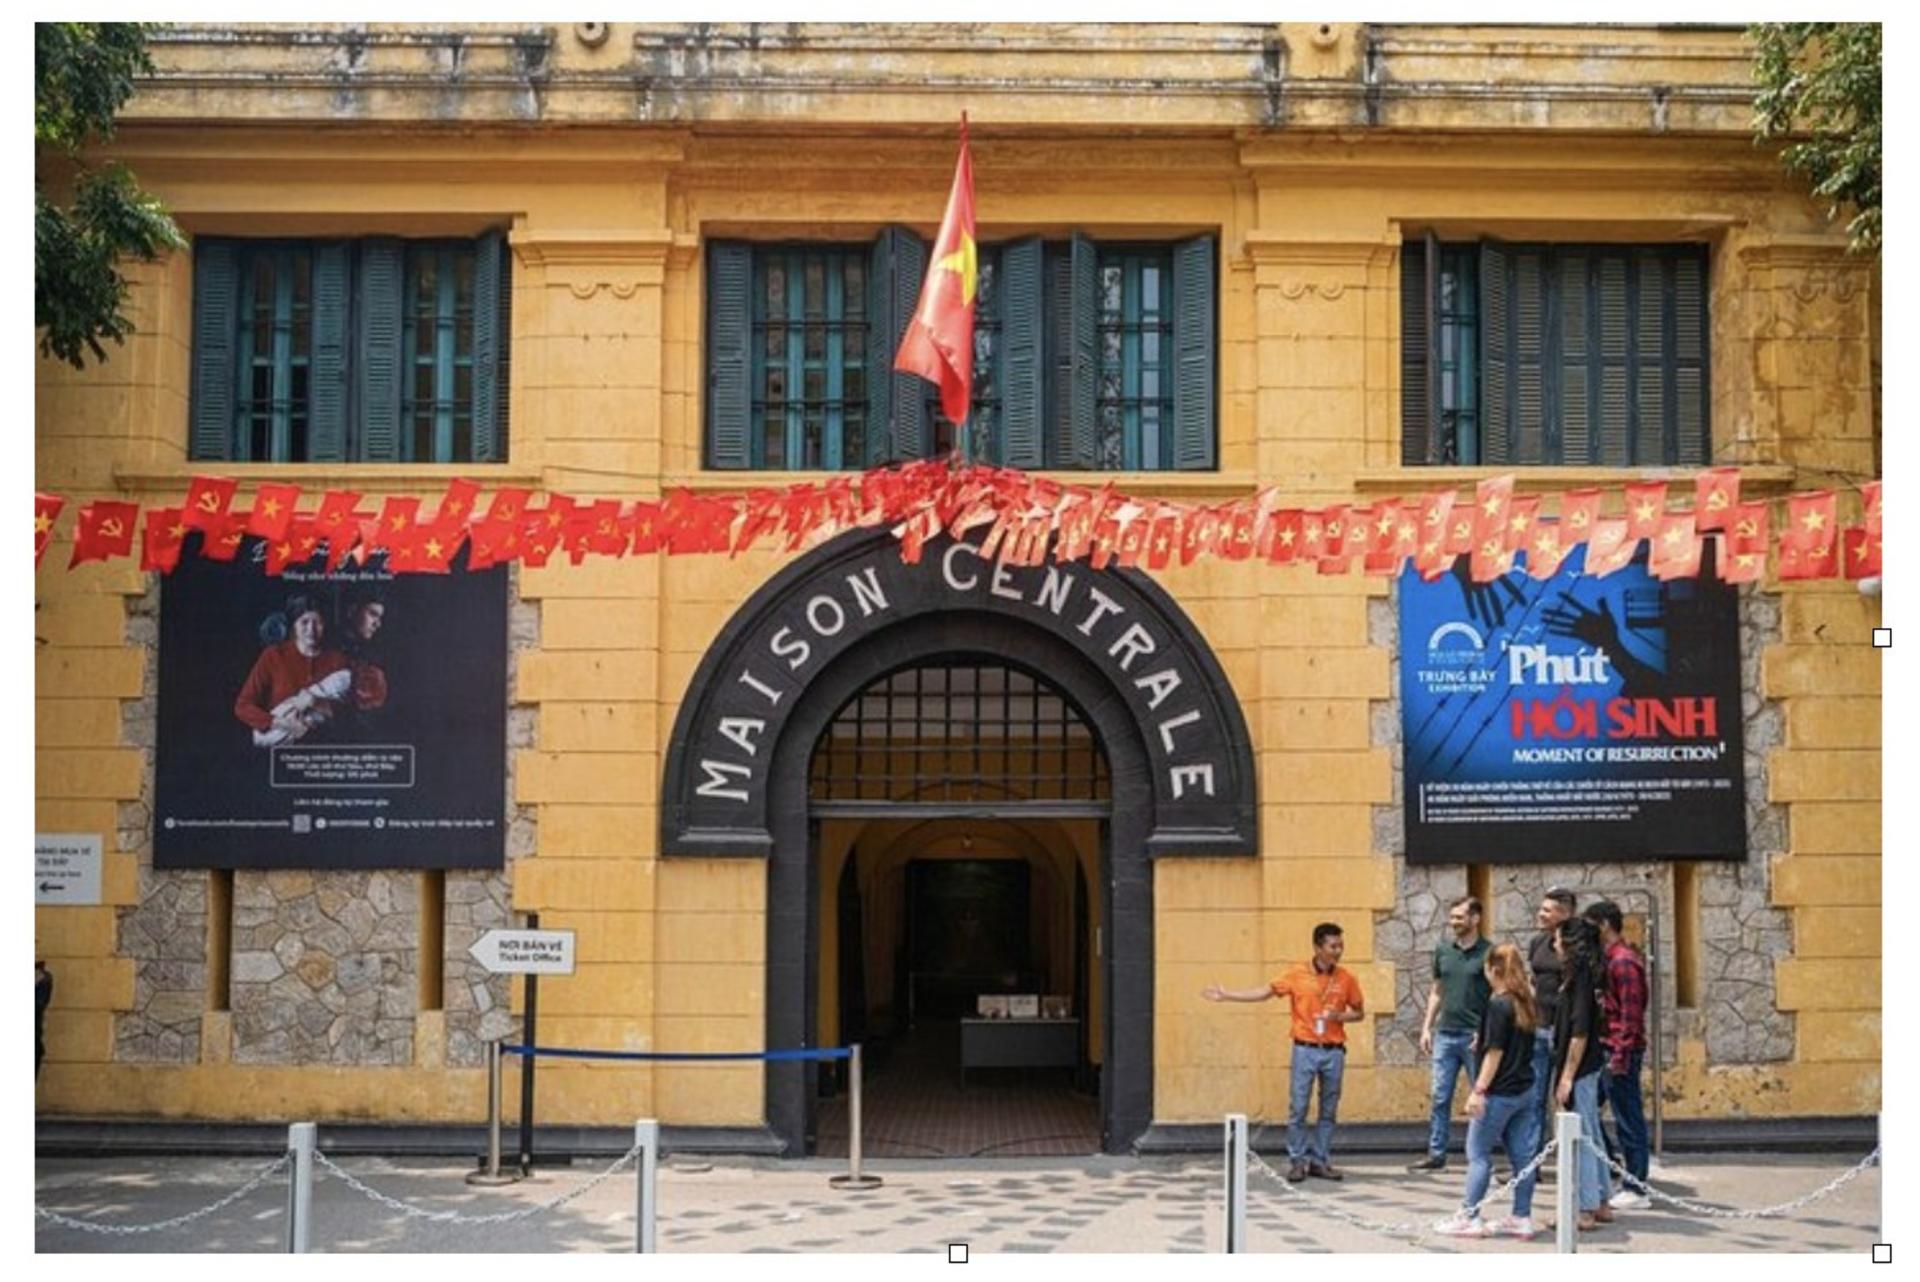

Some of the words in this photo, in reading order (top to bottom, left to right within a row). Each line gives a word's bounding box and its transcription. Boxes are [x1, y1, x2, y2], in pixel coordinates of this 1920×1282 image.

[696, 567, 889, 802] MAISON
[942, 542, 1216, 799] CENTRALE
[1606, 696, 1718, 739] SINH
[1513, 748, 1581, 762] MOMENT
[1584, 748, 1607, 761] OF
[499, 940, 520, 950] NƠI
[523, 939, 546, 950] BÁN
[550, 939, 562, 951] VÉ
[499, 952, 530, 962] Ticket
[532, 952, 562, 962] Office
